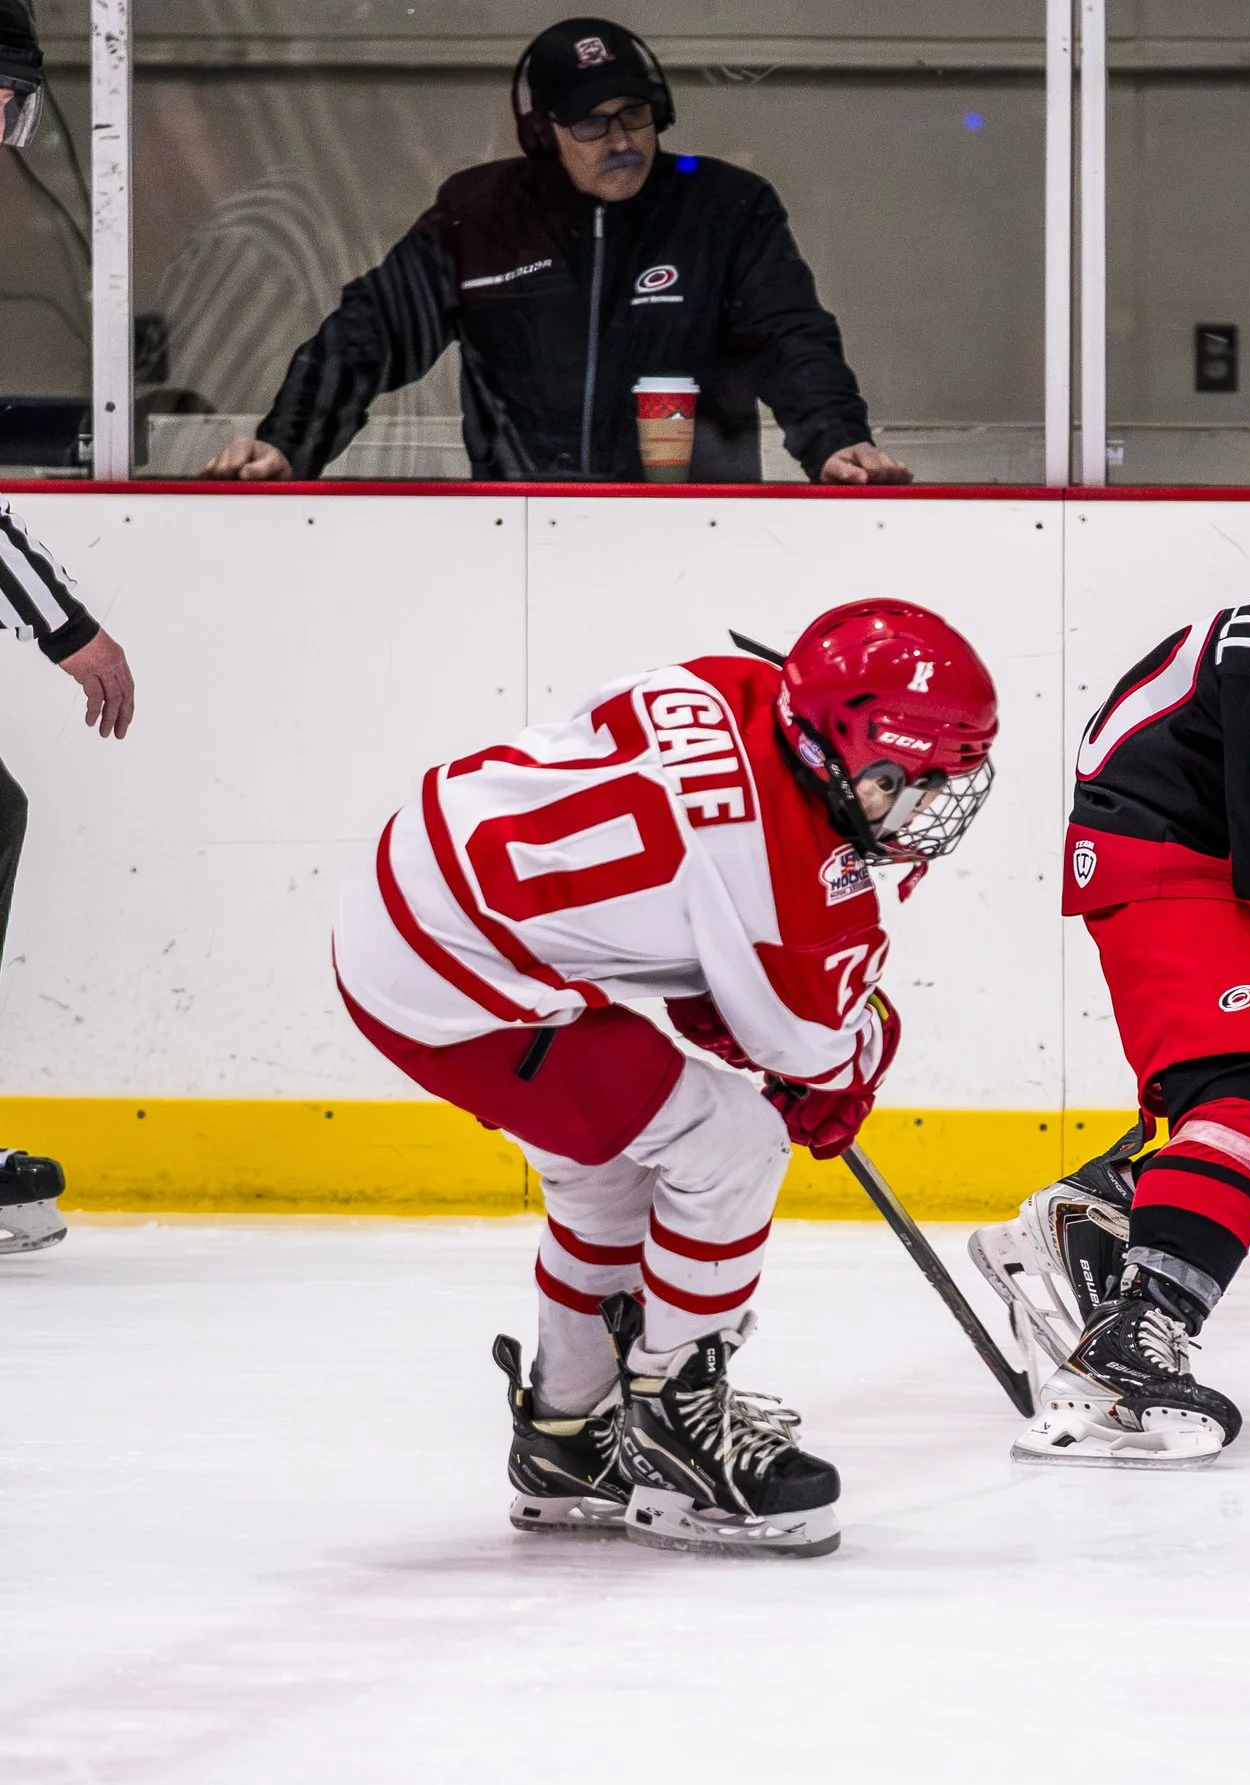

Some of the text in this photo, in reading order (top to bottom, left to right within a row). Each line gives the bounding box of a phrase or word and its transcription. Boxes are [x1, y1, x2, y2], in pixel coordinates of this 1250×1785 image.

[906, 661, 936, 693] K
[878, 731, 933, 751] CCM
[831, 866, 870, 891] HOCKE
[1080, 1258, 1100, 1307] BAUE
